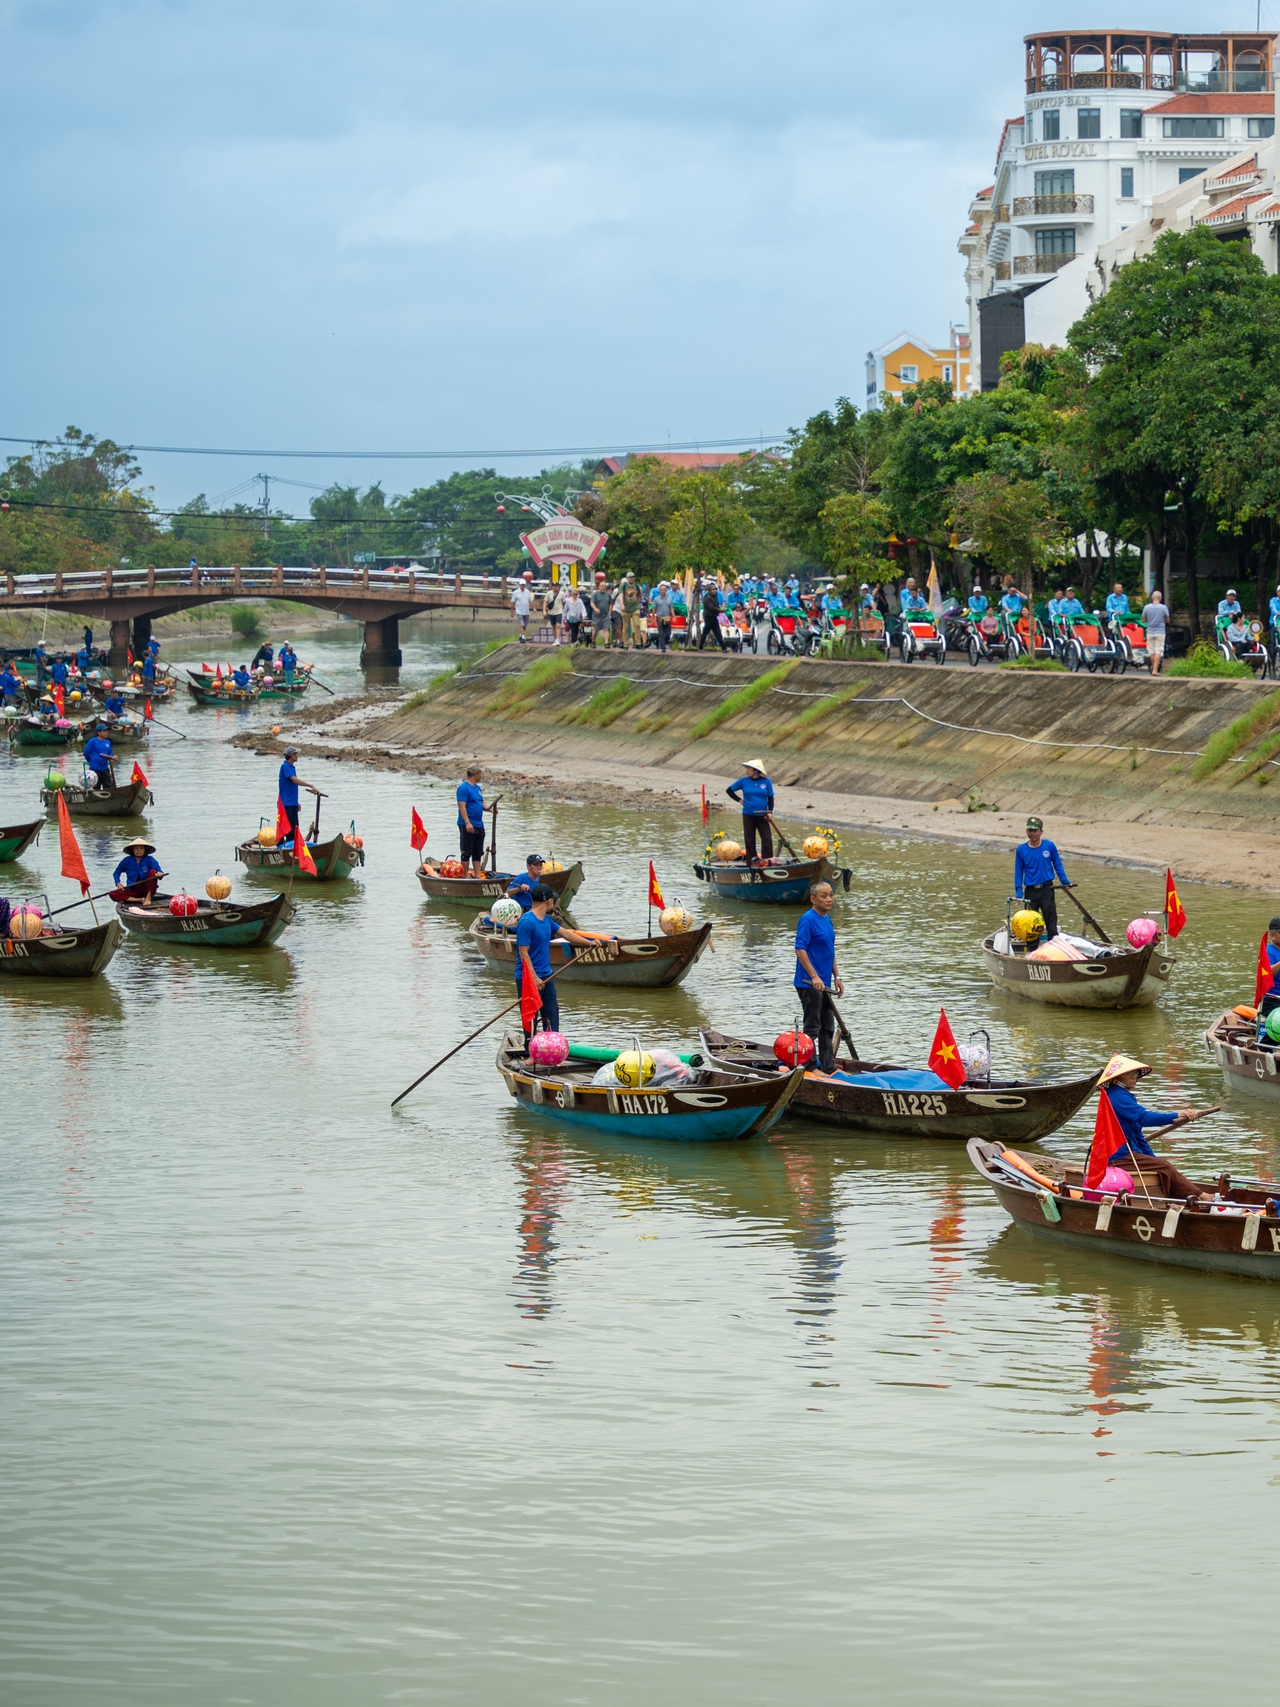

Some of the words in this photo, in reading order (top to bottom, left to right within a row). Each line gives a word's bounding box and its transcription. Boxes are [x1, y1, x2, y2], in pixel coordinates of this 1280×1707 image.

[1066, 96, 1091, 106] BAR
[1051, 143, 1097, 158] ROYAL
[547, 543, 562, 552] NIGHT
[562, 543, 583, 553] MARKET
[643, 1094, 669, 1114] 172
[881, 1092, 948, 1116] HA225
